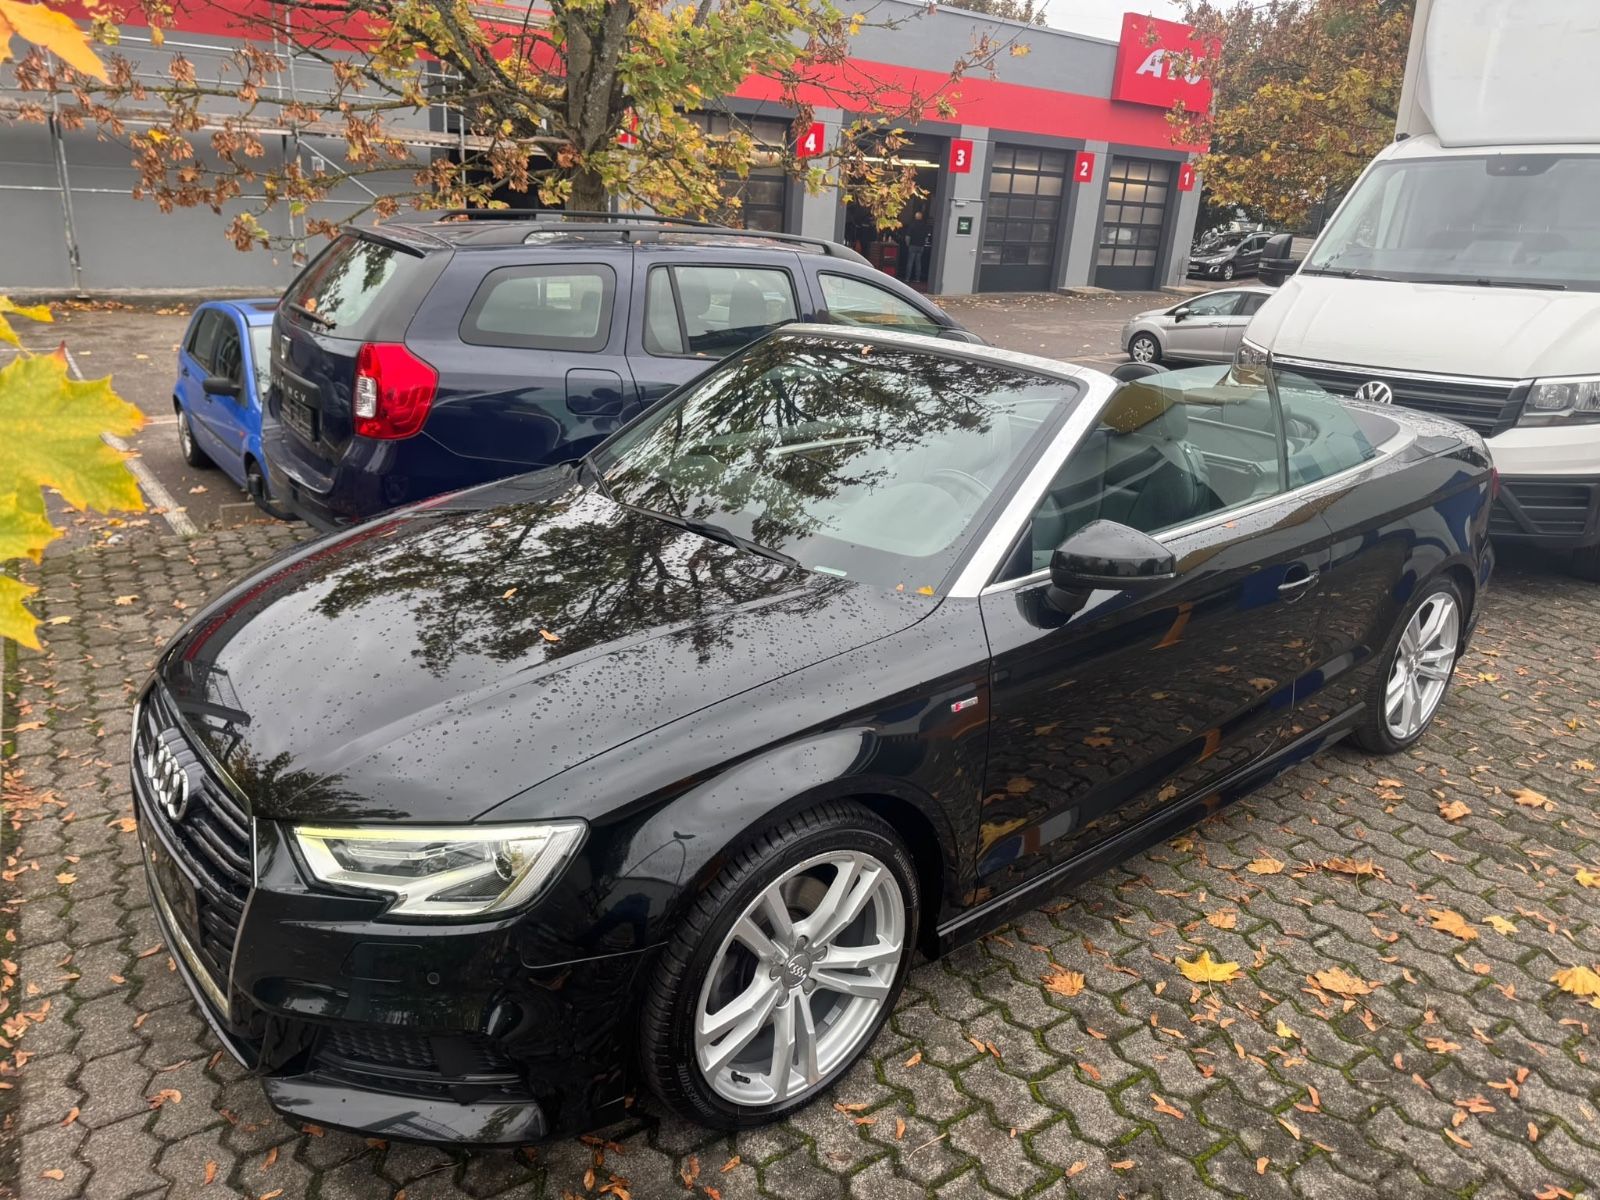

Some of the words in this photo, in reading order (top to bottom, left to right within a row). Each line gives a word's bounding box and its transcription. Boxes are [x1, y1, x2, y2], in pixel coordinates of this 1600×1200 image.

[805, 133, 816, 152] 4
[955, 149, 966, 167] 3
[1080, 161, 1089, 177] 2
[1183, 171, 1190, 186] 1
